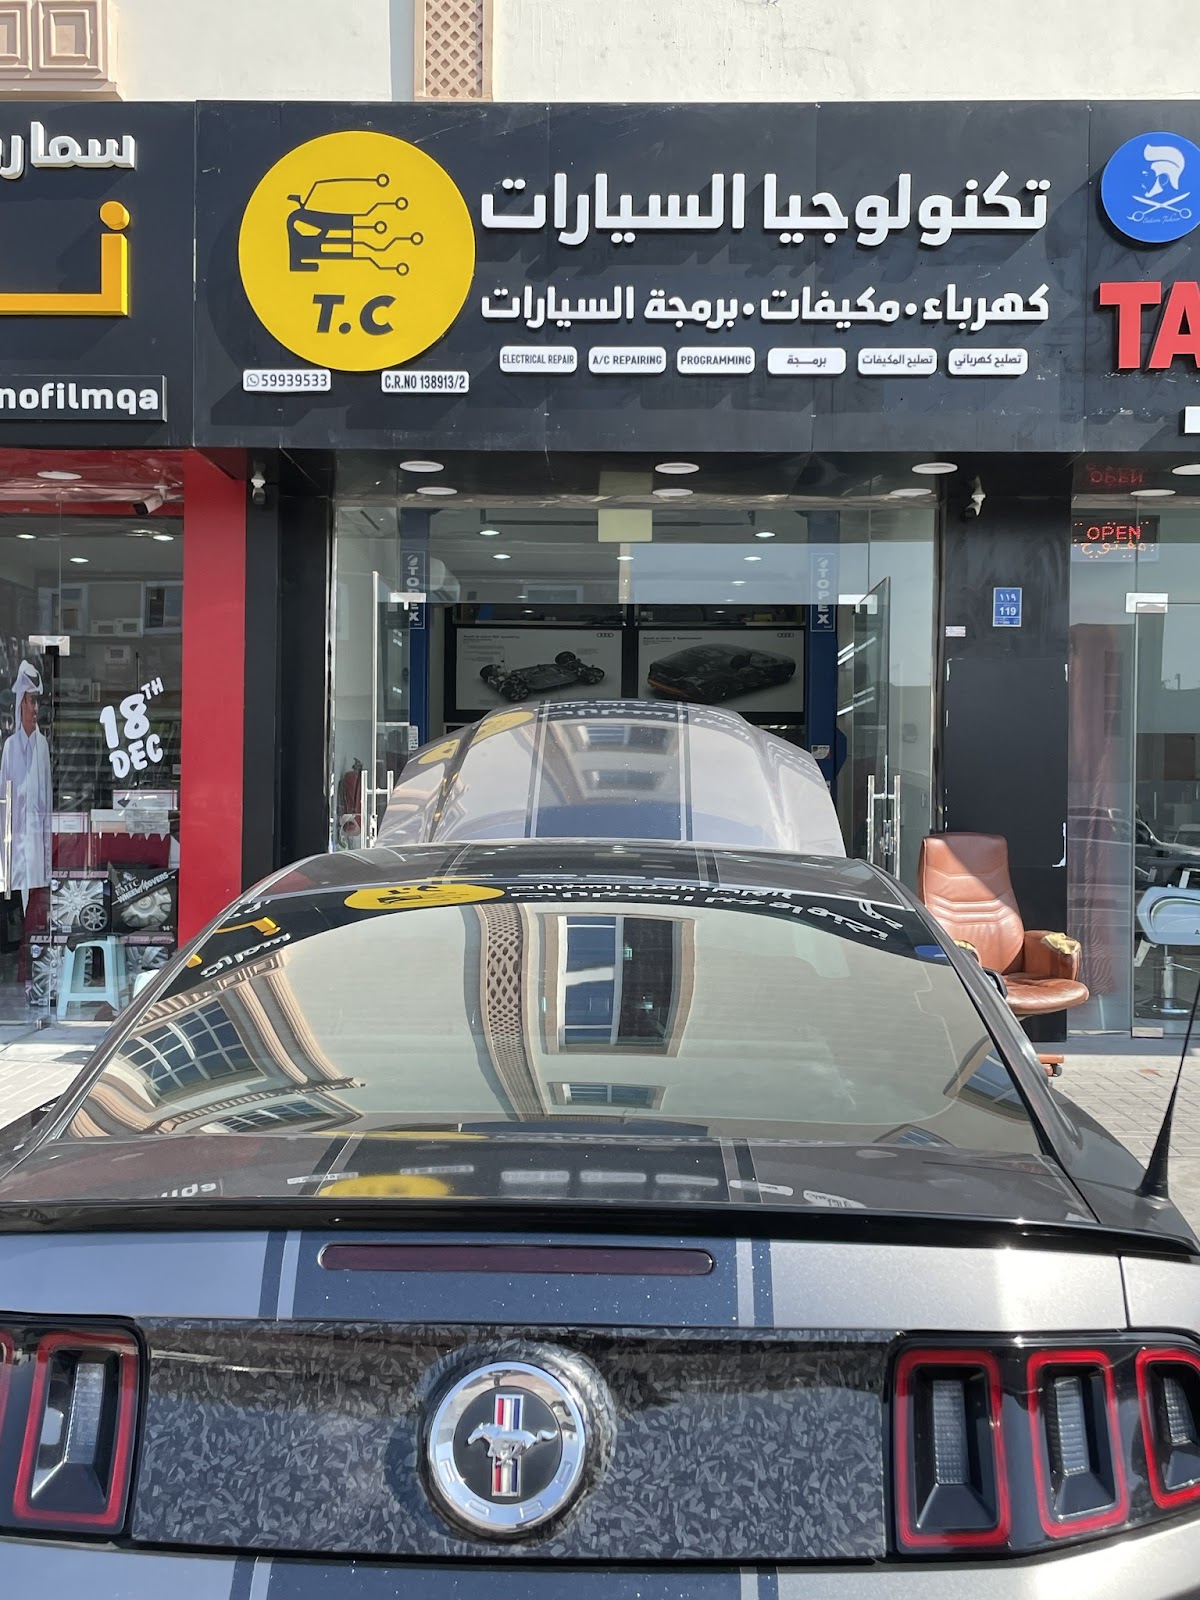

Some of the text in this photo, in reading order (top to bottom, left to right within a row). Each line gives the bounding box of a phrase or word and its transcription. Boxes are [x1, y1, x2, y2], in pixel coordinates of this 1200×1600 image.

[481, 170, 1051, 247] تكنولوجيا السيارات
[481, 283, 1049, 331] كهرباء مكيفات برمجة السيارات
[312, 294, 397, 336] T.C
[1099, 281, 1200, 369] TA
[502, 354, 575, 365] ELECTRICAL REPAIR
[592, 355, 662, 366] A/C REPAIRING
[680, 355, 752, 366] PROGRAMMING
[862, 354, 933, 367] تصليح المكيفات
[993, 353, 1021, 367] تصليح
[261, 373, 327, 388] 59939533
[384, 374, 466, 390] C.R.NO 138913/2
[1086, 526, 1141, 541] OPEN
[816, 568, 830, 624] TOPEX
[1000, 593, 1017, 602] ١١٩
[1000, 606, 1017, 616] 119
[109, 733, 163, 778] DEC
